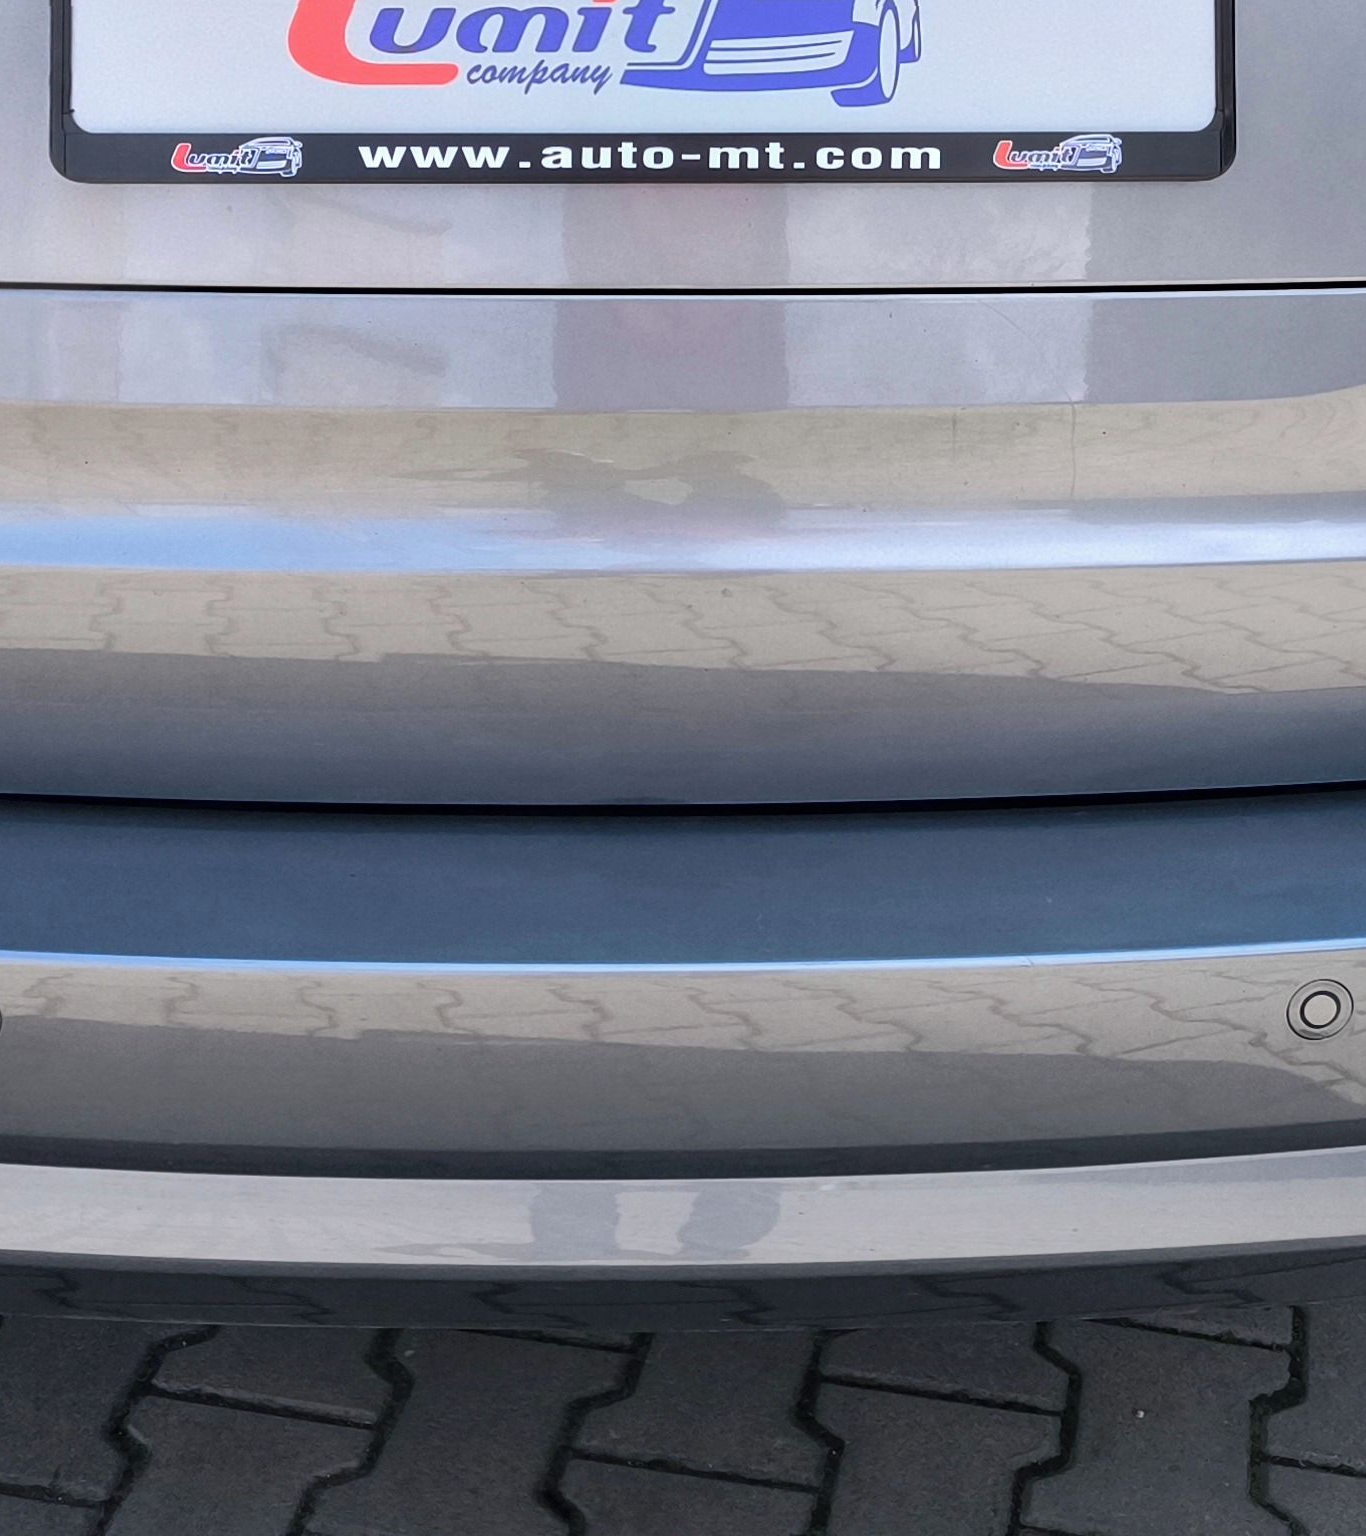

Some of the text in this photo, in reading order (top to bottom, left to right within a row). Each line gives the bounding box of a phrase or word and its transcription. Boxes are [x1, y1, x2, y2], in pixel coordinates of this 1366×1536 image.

[466, 58, 614, 96] company
[171, 143, 253, 172] Lumit
[357, 141, 942, 170] www.auto-mt.com
[993, 140, 1073, 169] Lumit
